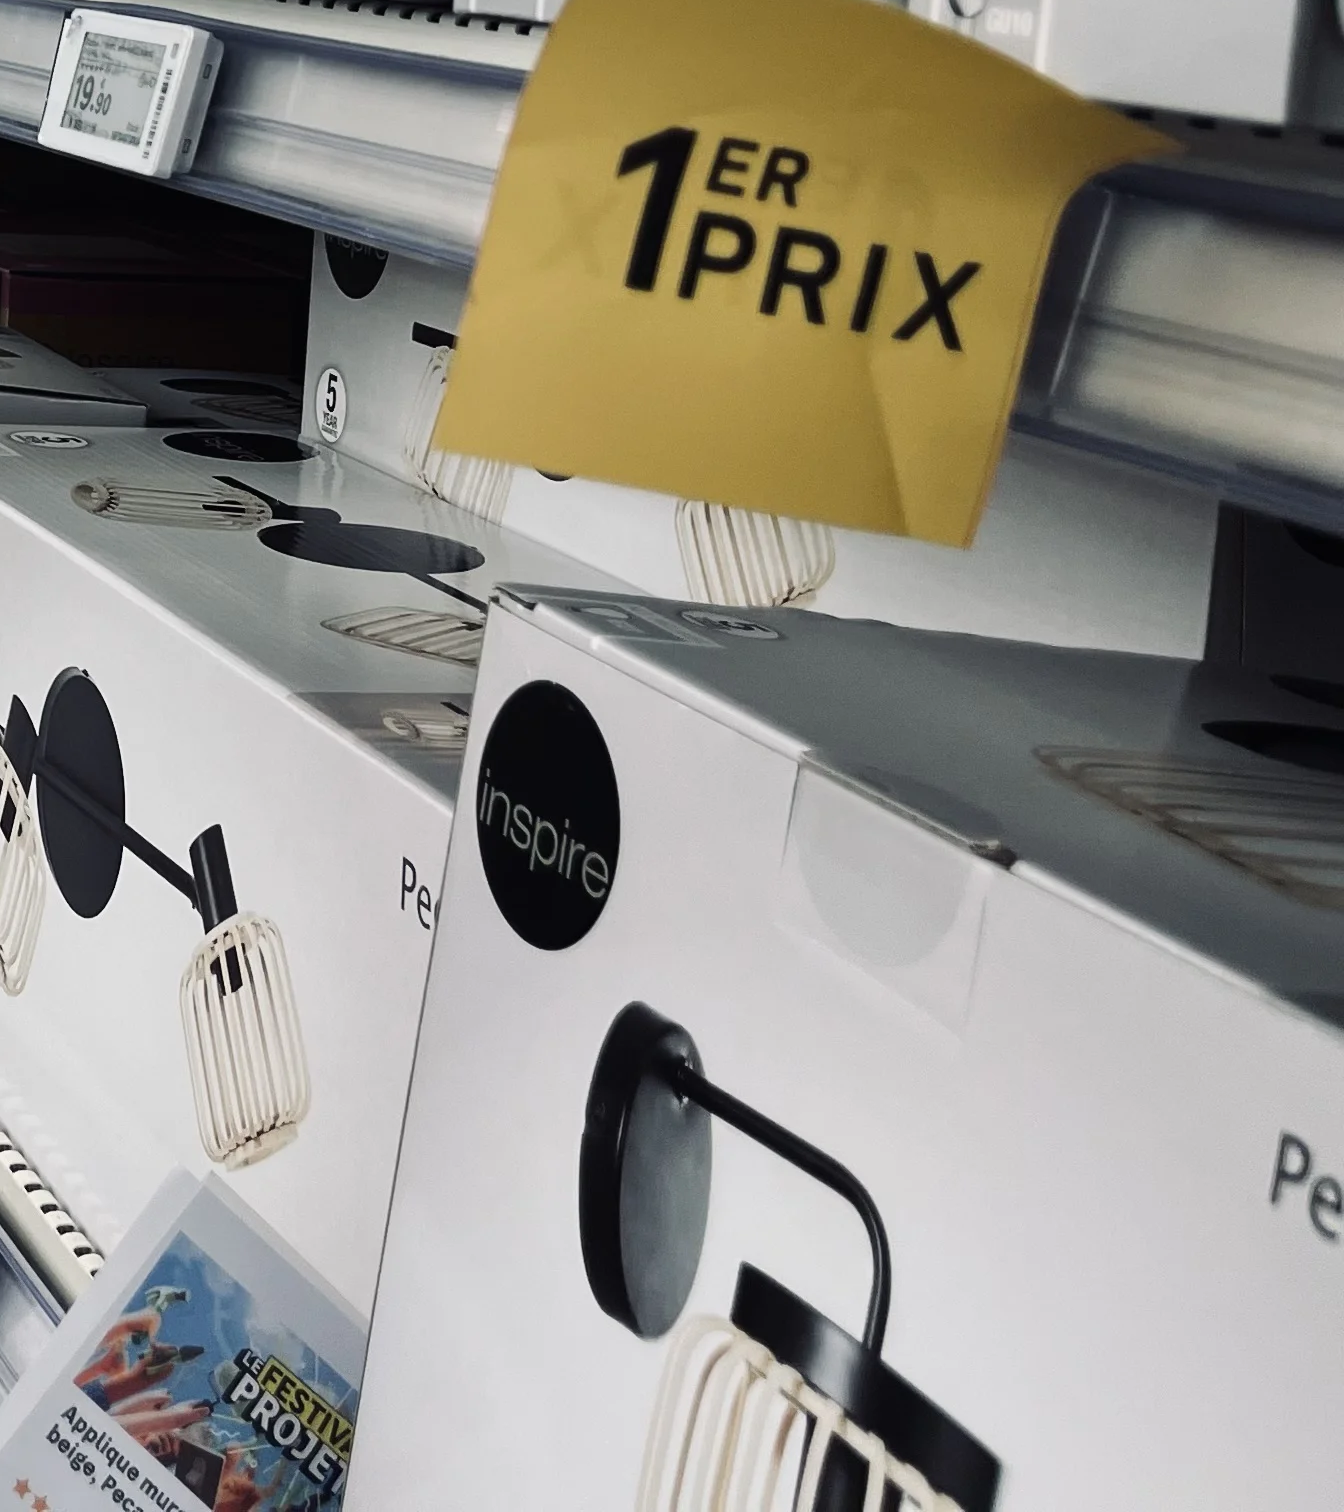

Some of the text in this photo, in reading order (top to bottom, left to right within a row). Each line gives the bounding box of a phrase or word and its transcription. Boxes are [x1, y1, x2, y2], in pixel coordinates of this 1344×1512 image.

[616, 124, 811, 293] 1 ER
[677, 210, 983, 354] PRIX
[325, 372, 338, 413] 5
[478, 767, 610, 898] inspire
[400, 856, 439, 931] Pe
[60, 1405, 141, 1482] Applique
[231, 1373, 348, 1493] PROJET
[242, 1349, 354, 1454] LE FESTIVA
[45, 1422, 144, 1512] beige, Peca
